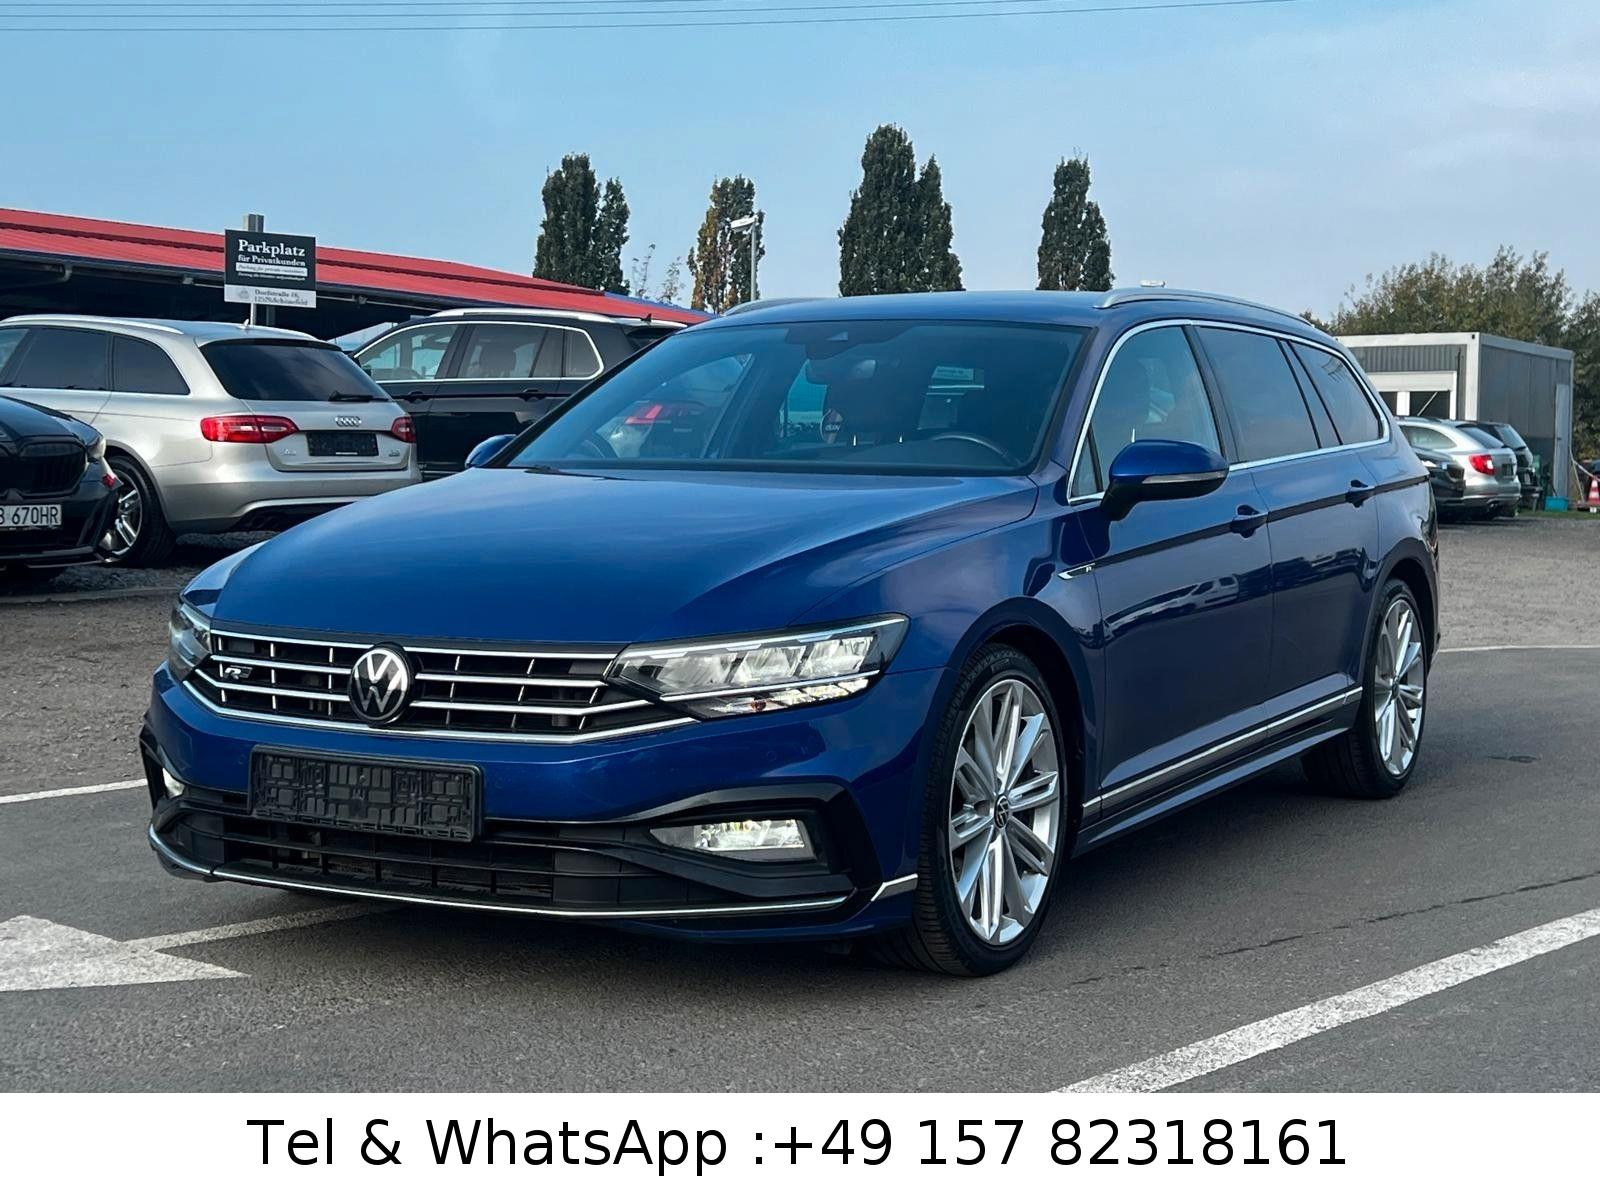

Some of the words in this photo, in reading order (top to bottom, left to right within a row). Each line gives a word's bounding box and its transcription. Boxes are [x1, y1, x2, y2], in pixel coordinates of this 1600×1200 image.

[238, 239, 306, 258] Parkplatz
[237, 254, 250, 263] für
[252, 255, 306, 267] Privatkunden
[12, 506, 59, 525] 670HR
